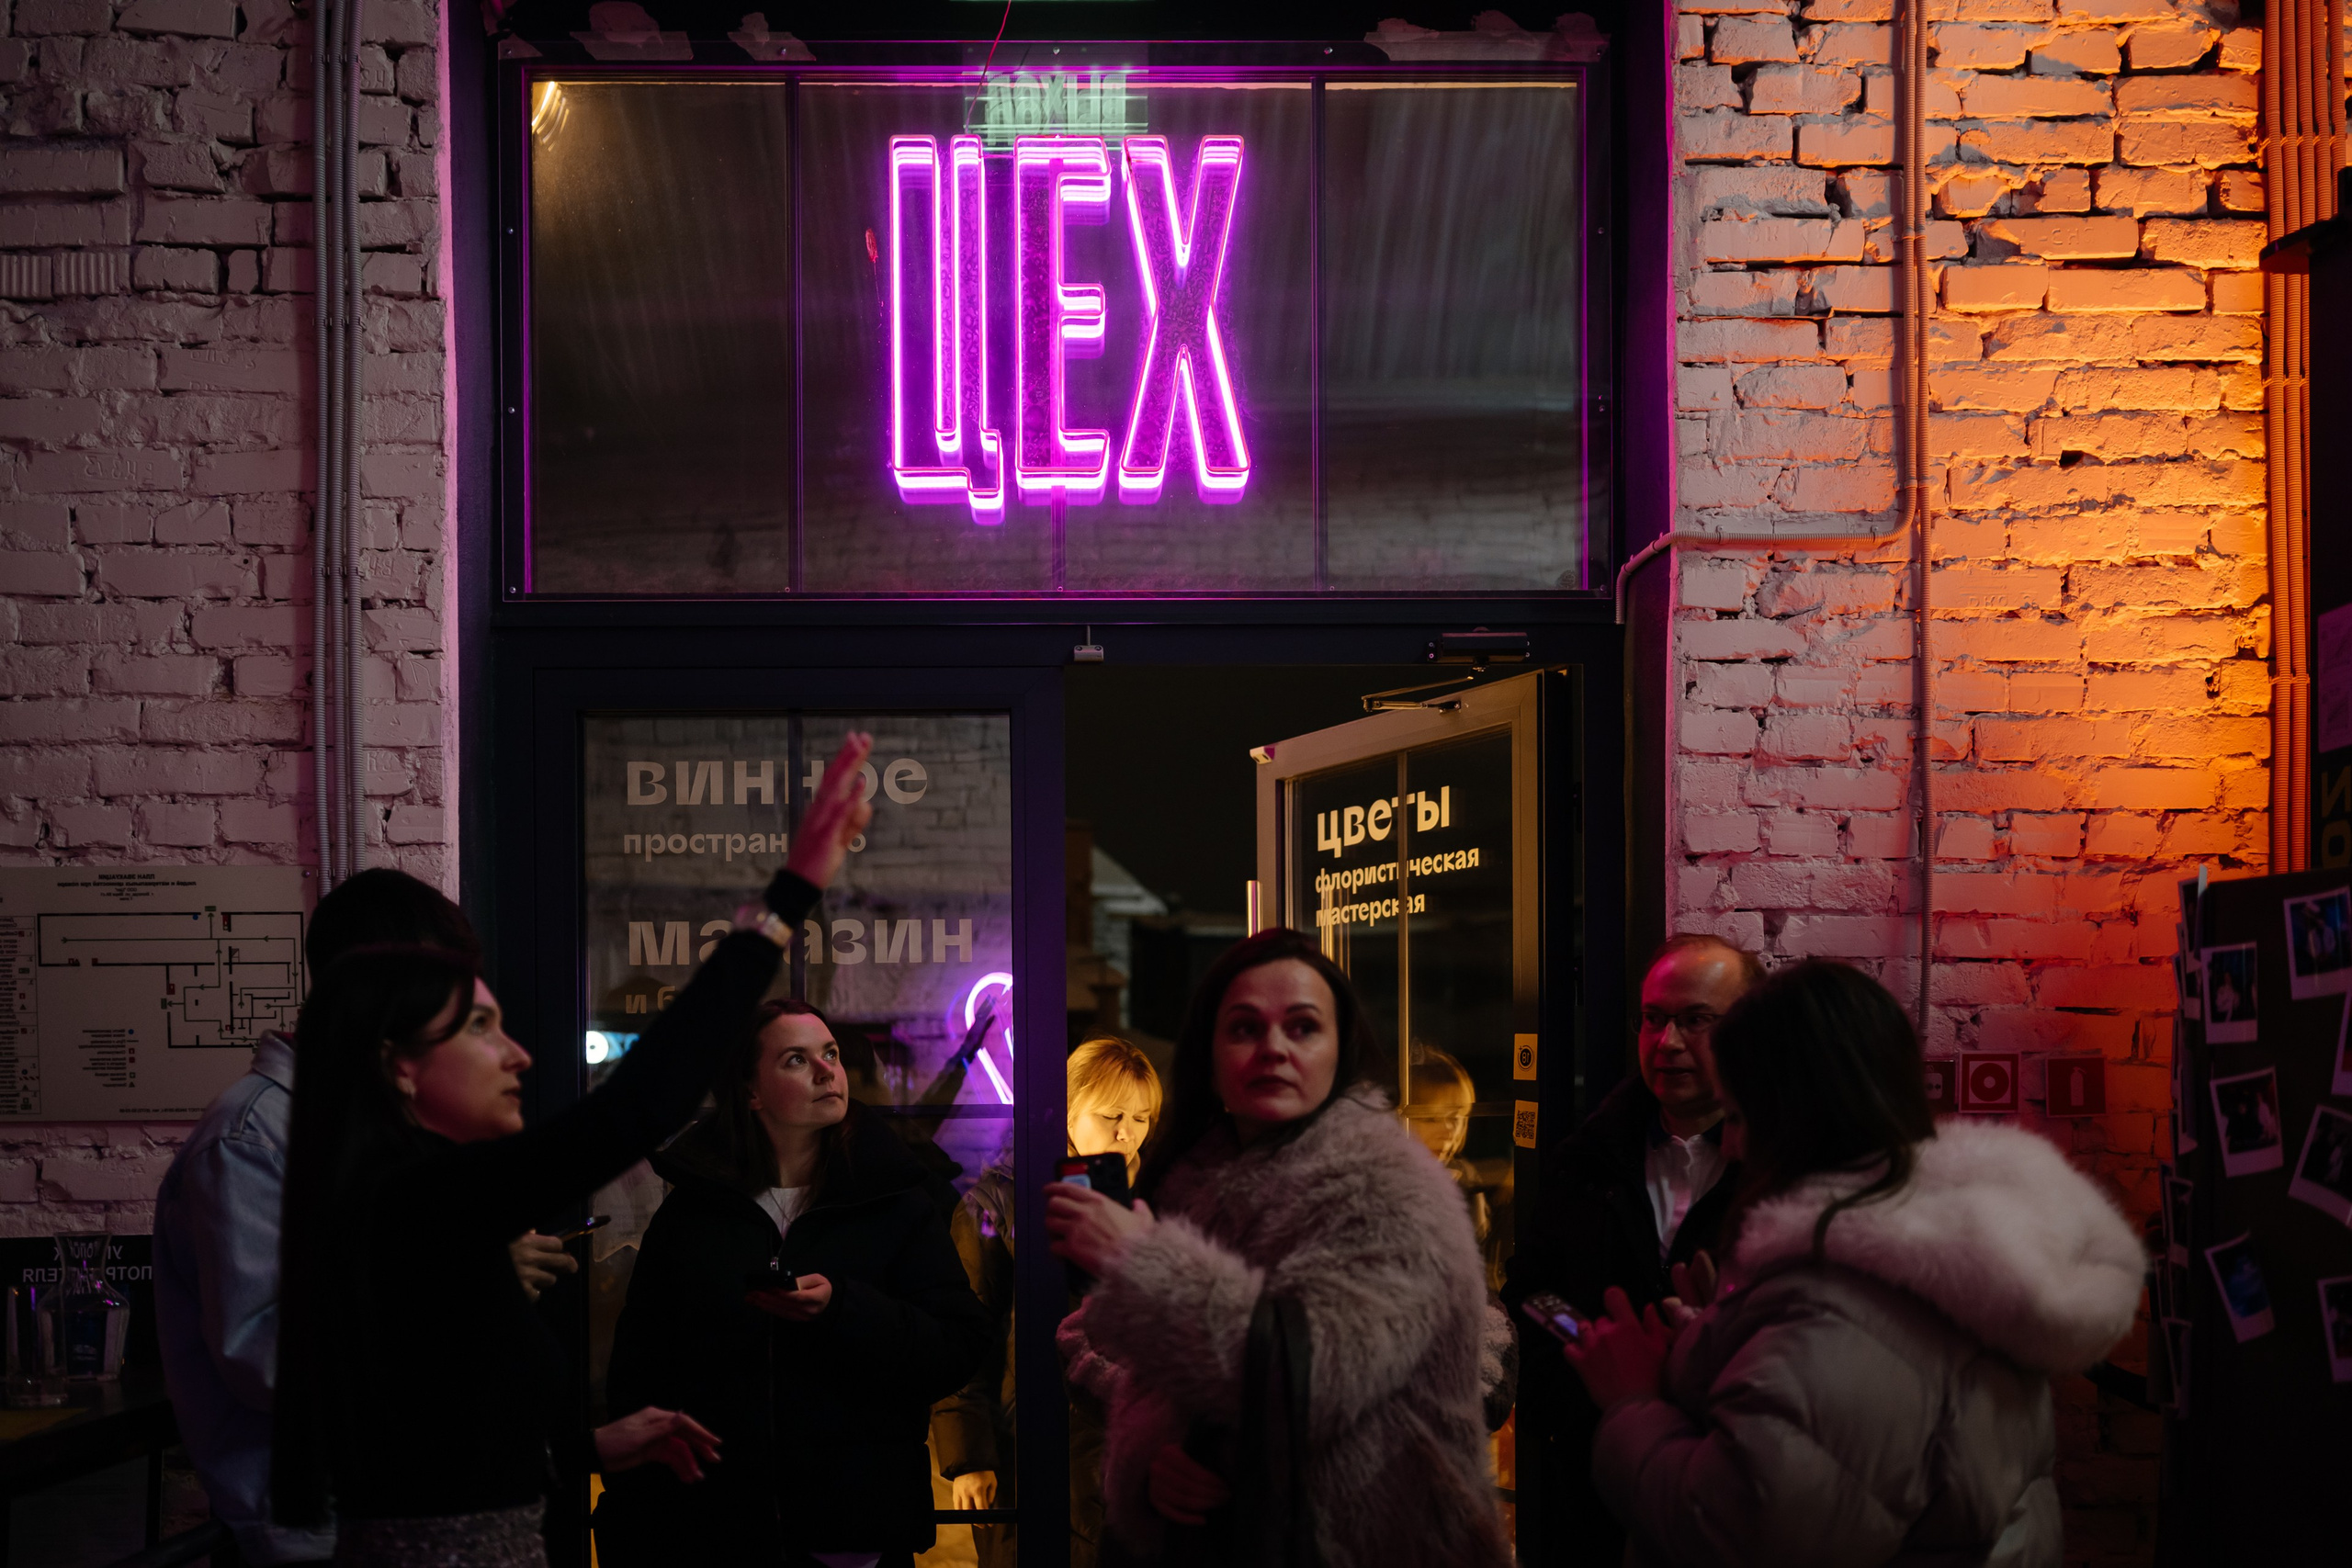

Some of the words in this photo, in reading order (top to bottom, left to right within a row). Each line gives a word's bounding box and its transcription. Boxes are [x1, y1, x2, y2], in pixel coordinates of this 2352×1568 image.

[889, 134, 1250, 516] ЦЕХ
[624, 831, 866, 863] пространо
[1315, 847, 1479, 895] флористческая
[628, 919, 973, 965] маазин
[626, 994, 647, 1014] и
